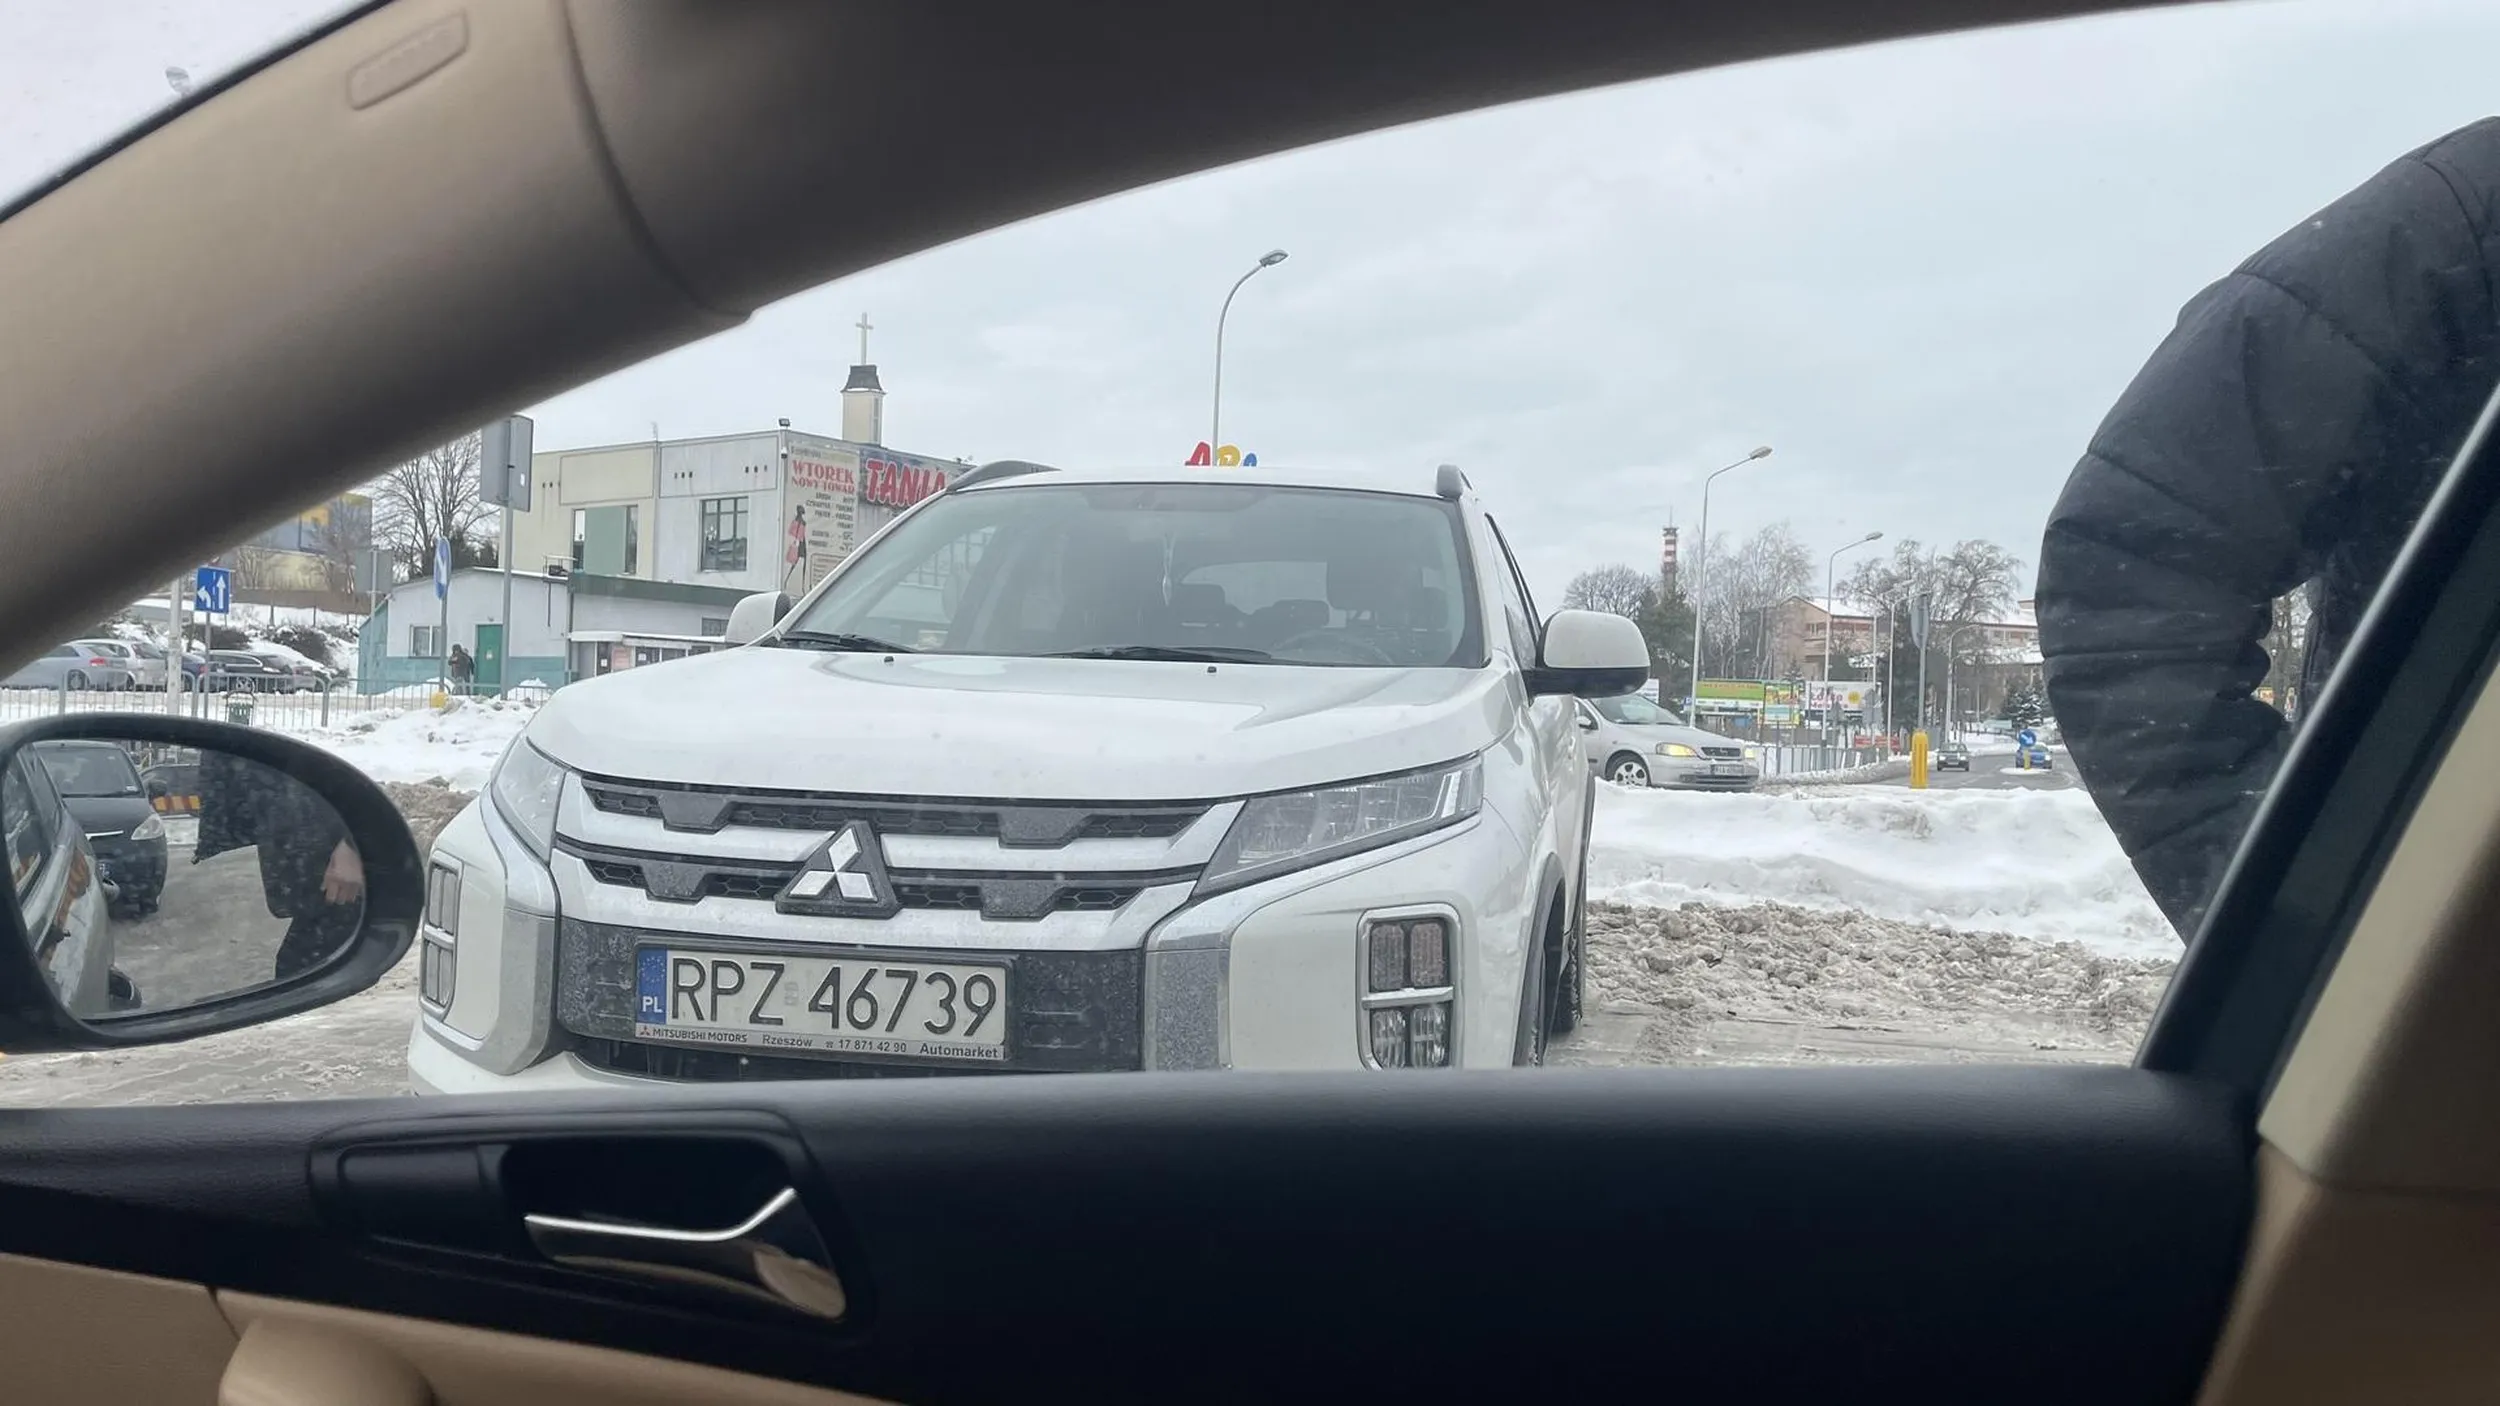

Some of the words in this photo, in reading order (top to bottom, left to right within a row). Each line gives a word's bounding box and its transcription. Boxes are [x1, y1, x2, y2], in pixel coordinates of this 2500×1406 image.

[792, 460, 854, 484] WTOREK
[791, 476, 819, 489] NOWY
[821, 481, 855, 496] TOWAR
[642, 996, 663, 1013] PL
[672, 957, 785, 1026] RPZ
[808, 966, 997, 1037] 46739
[652, 1029, 706, 1041] MITSUBISHI
[708, 1032, 748, 1044] MOTORS
[762, 1034, 813, 1048] Rzeszów
[838, 1039, 851, 1050] 17
[854, 1040, 873, 1050] 871
[877, 1041, 891, 1052] 42
[919, 1043, 998, 1059] Automarket
